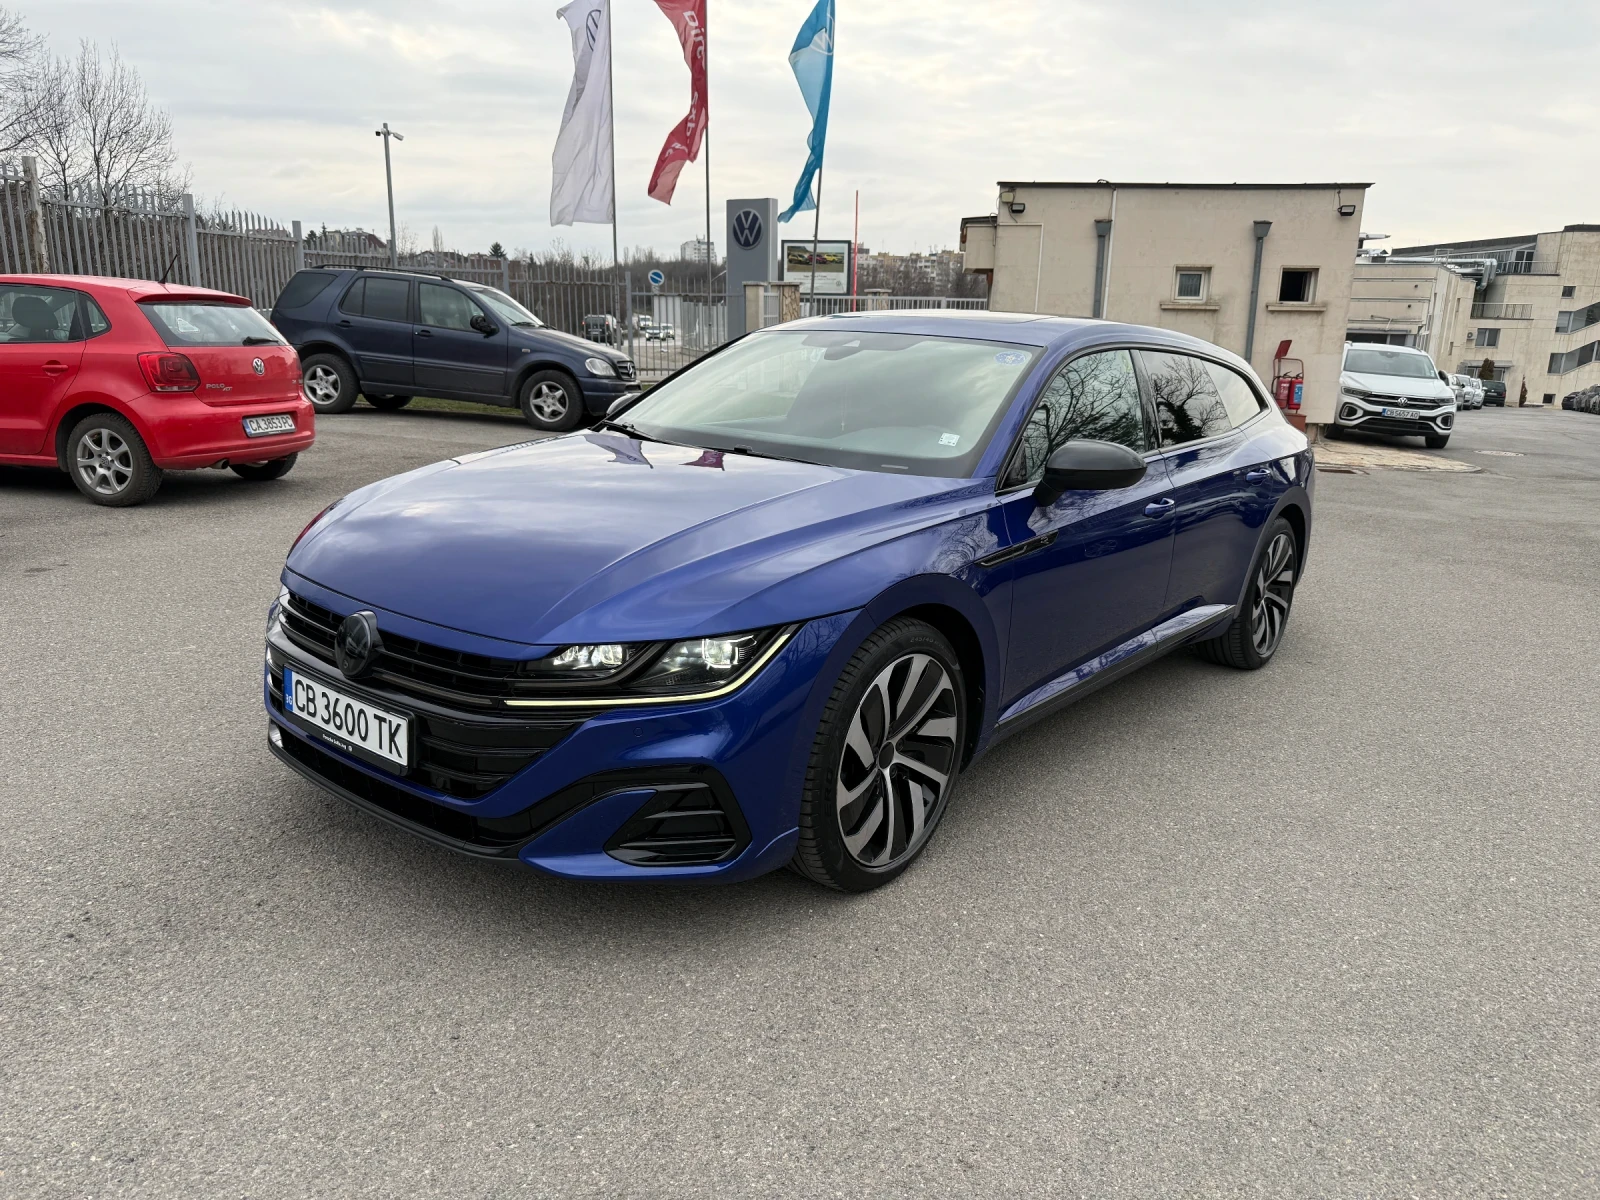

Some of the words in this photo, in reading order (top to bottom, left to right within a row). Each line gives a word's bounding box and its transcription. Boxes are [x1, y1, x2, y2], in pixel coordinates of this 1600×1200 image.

[295, 679, 317, 718] CB
[321, 692, 369, 742] 3600
[374, 713, 403, 758] TK
